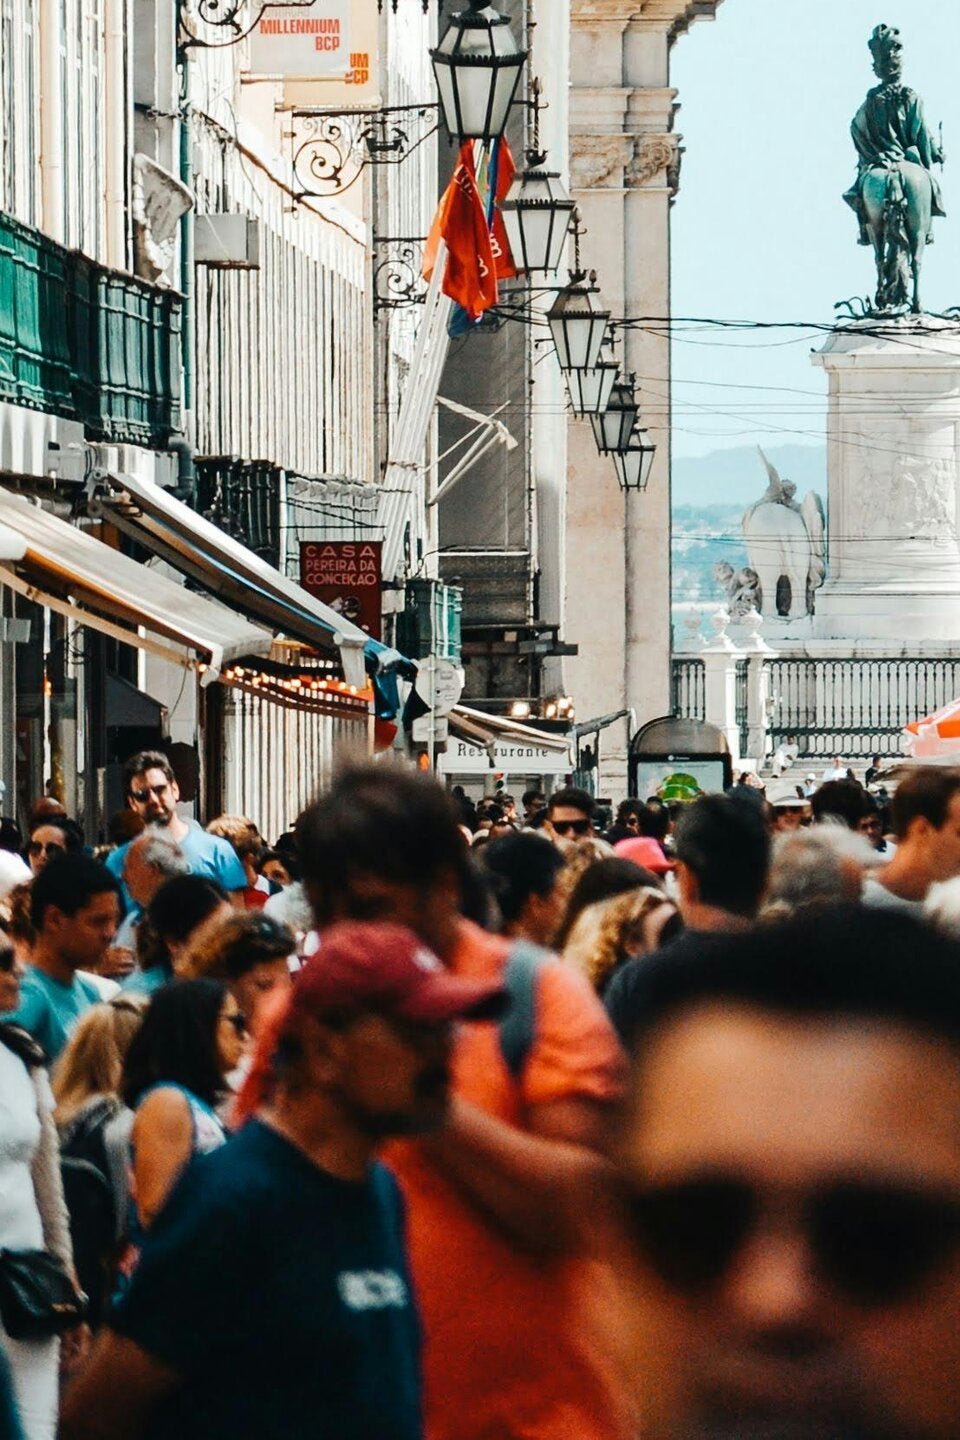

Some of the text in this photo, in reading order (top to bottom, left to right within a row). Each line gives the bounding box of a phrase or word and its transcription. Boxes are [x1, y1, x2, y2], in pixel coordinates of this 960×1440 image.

[260, 19, 340, 34] MILLENNIUM
[315, 36, 340, 51] BCP
[305, 545, 376, 558] CASA
[306, 560, 376, 571] PEREIRA DA
[457, 743, 549, 758] Resurante
